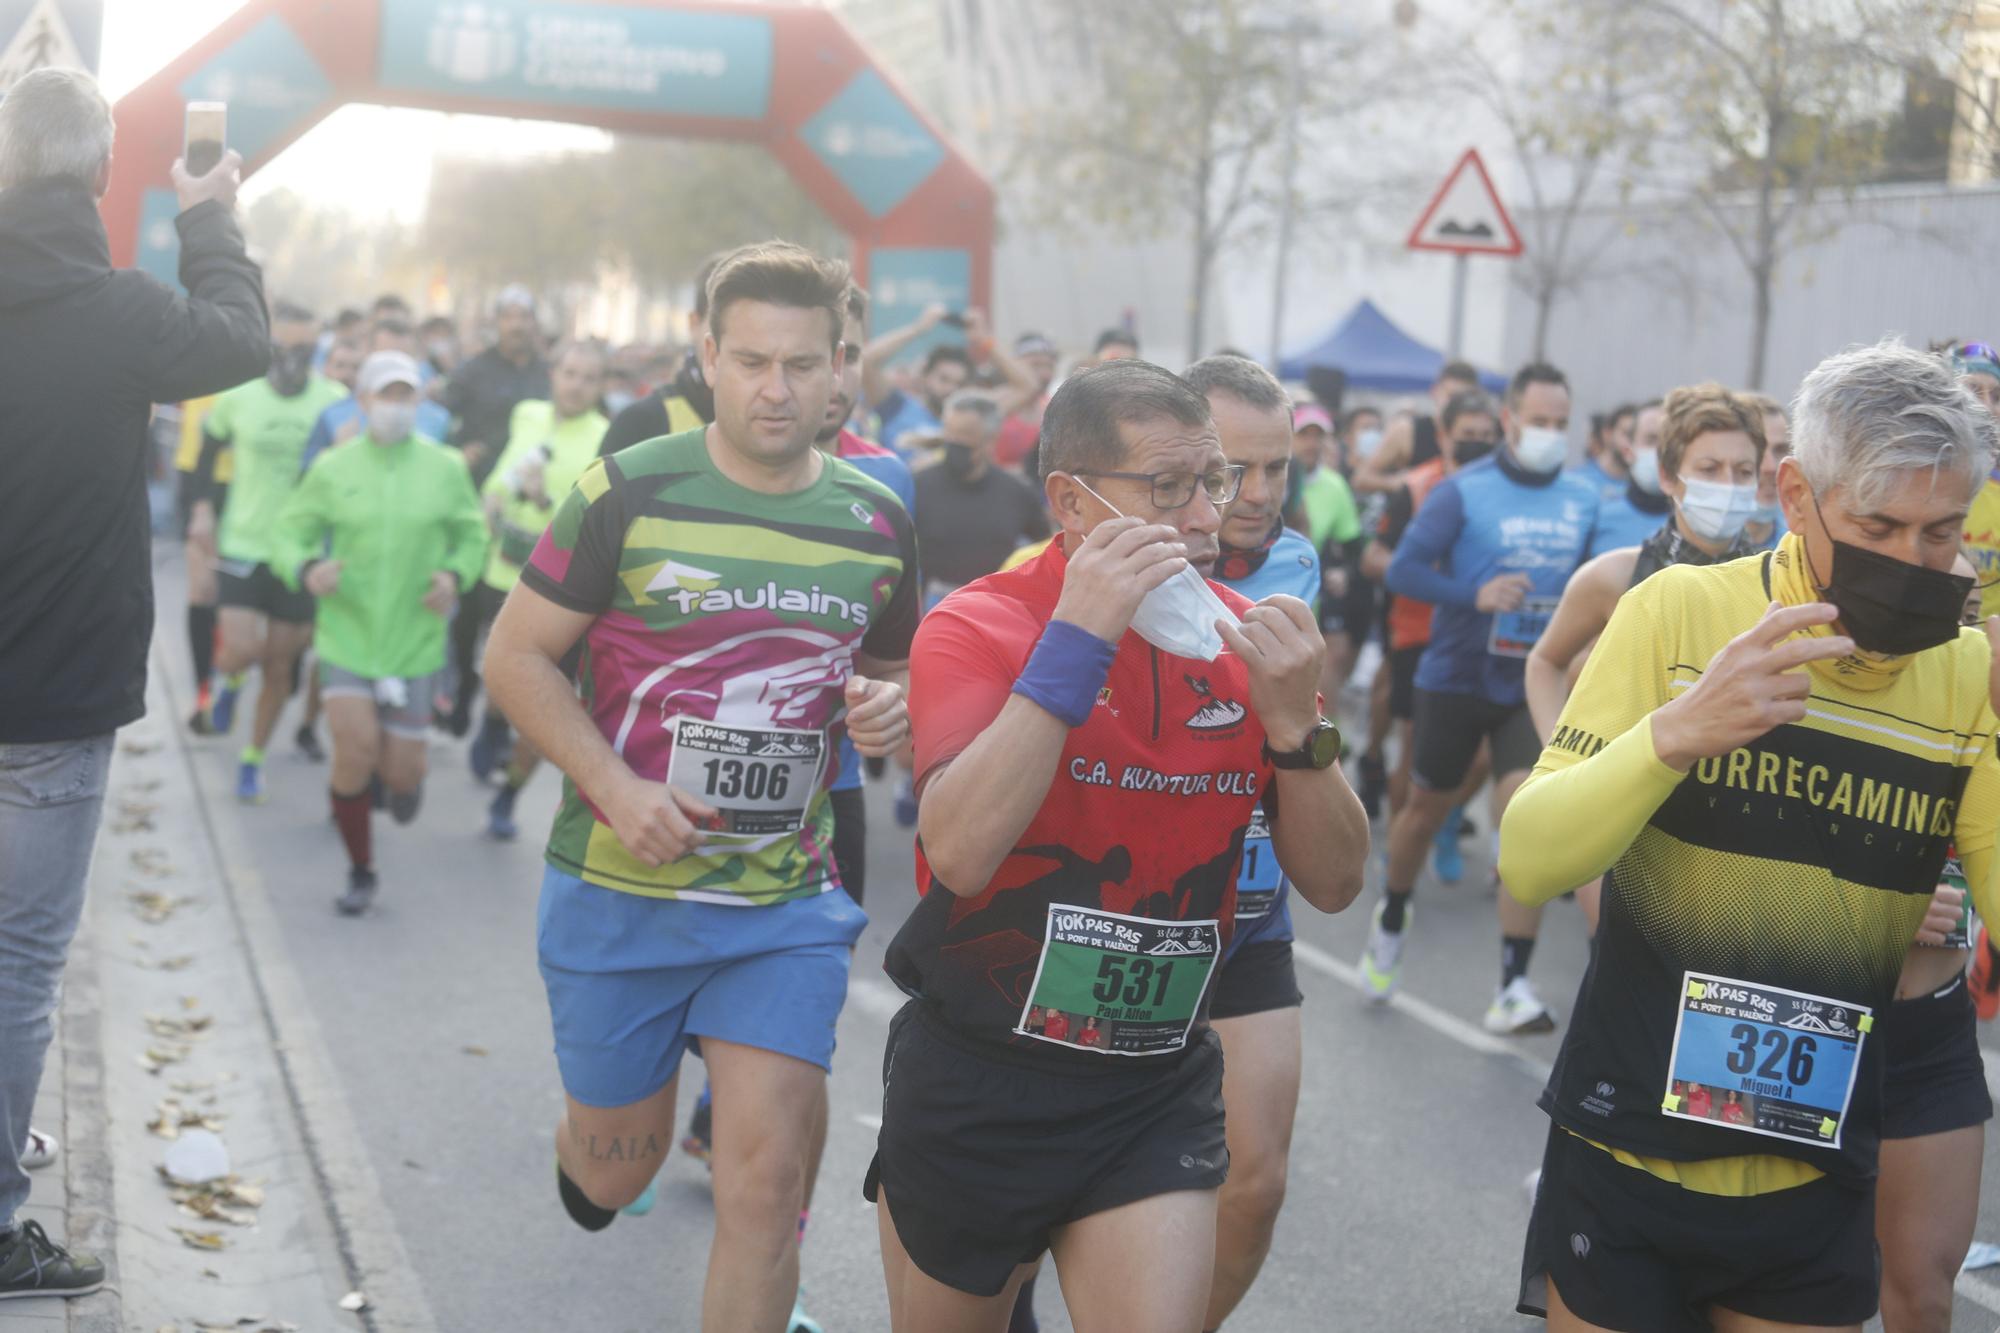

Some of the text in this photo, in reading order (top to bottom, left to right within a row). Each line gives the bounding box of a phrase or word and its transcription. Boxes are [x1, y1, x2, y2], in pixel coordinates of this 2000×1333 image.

[667, 581, 869, 625] taulains
[681, 724, 705, 738] 10K
[705, 728, 728, 740] PAS
[729, 732, 751, 747] RAS
[703, 758, 791, 801] 1306
[1070, 757, 1112, 785] C.A.
[1120, 766, 1212, 795] KUNTUR
[1055, 932, 1138, 953] AL PORT DE VALÈNCIA
[1056, 913, 1143, 944] 10K PAS RAS
[1092, 954, 1174, 1007] 531
[1096, 1003, 1123, 1019] Papi
[1689, 1001, 1773, 1023] AL PORT DE VALÈNCIA
[1720, 987, 1749, 1003] PAS
[1750, 994, 1778, 1014] RAS
[1726, 1023, 1818, 1086] 326
[1740, 1077, 1793, 1099] Miguel A
[588, 1133, 659, 1161] LAIA
